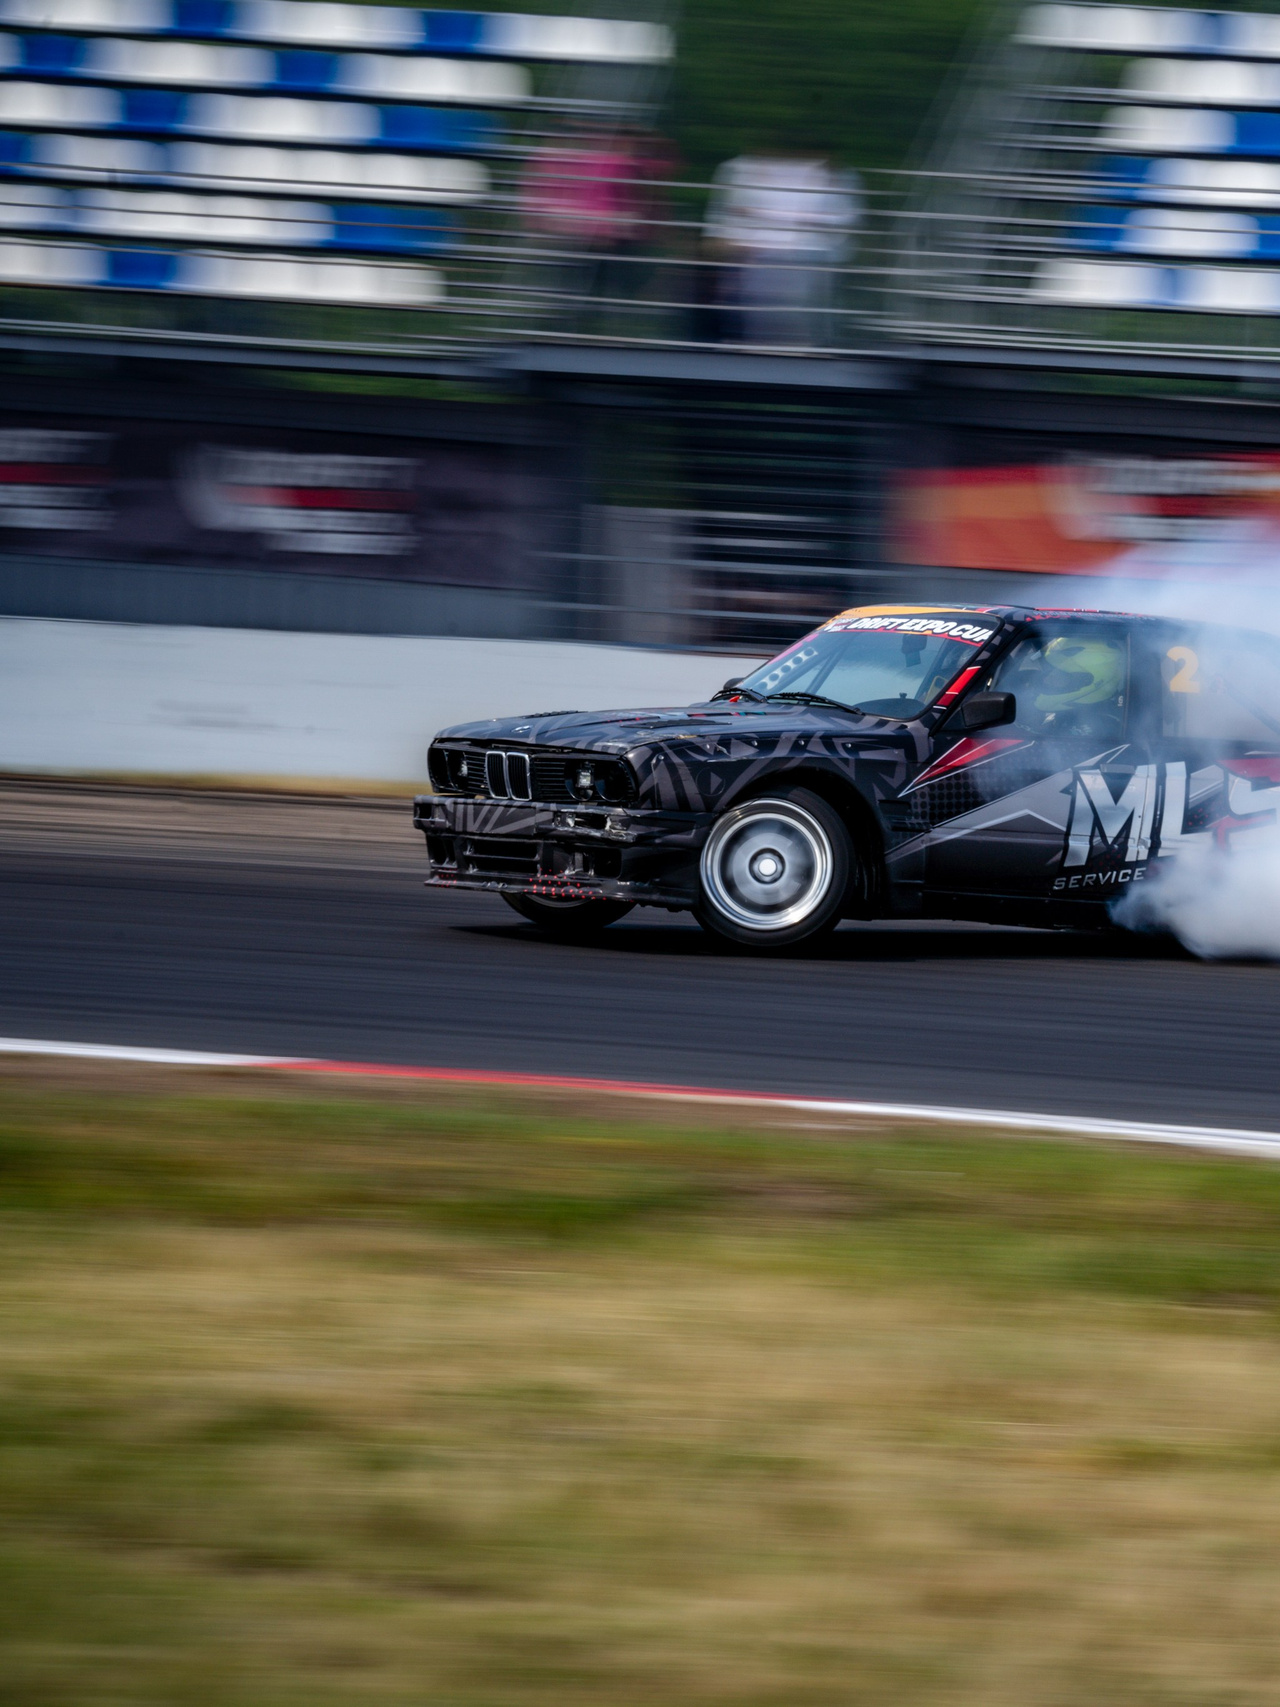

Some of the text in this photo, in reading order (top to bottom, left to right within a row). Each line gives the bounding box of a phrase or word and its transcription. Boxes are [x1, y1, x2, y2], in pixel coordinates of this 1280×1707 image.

[847, 617, 905, 630] DRIFT
[900, 618, 958, 634] EXPO
[1053, 867, 1147, 890] SERVICE
